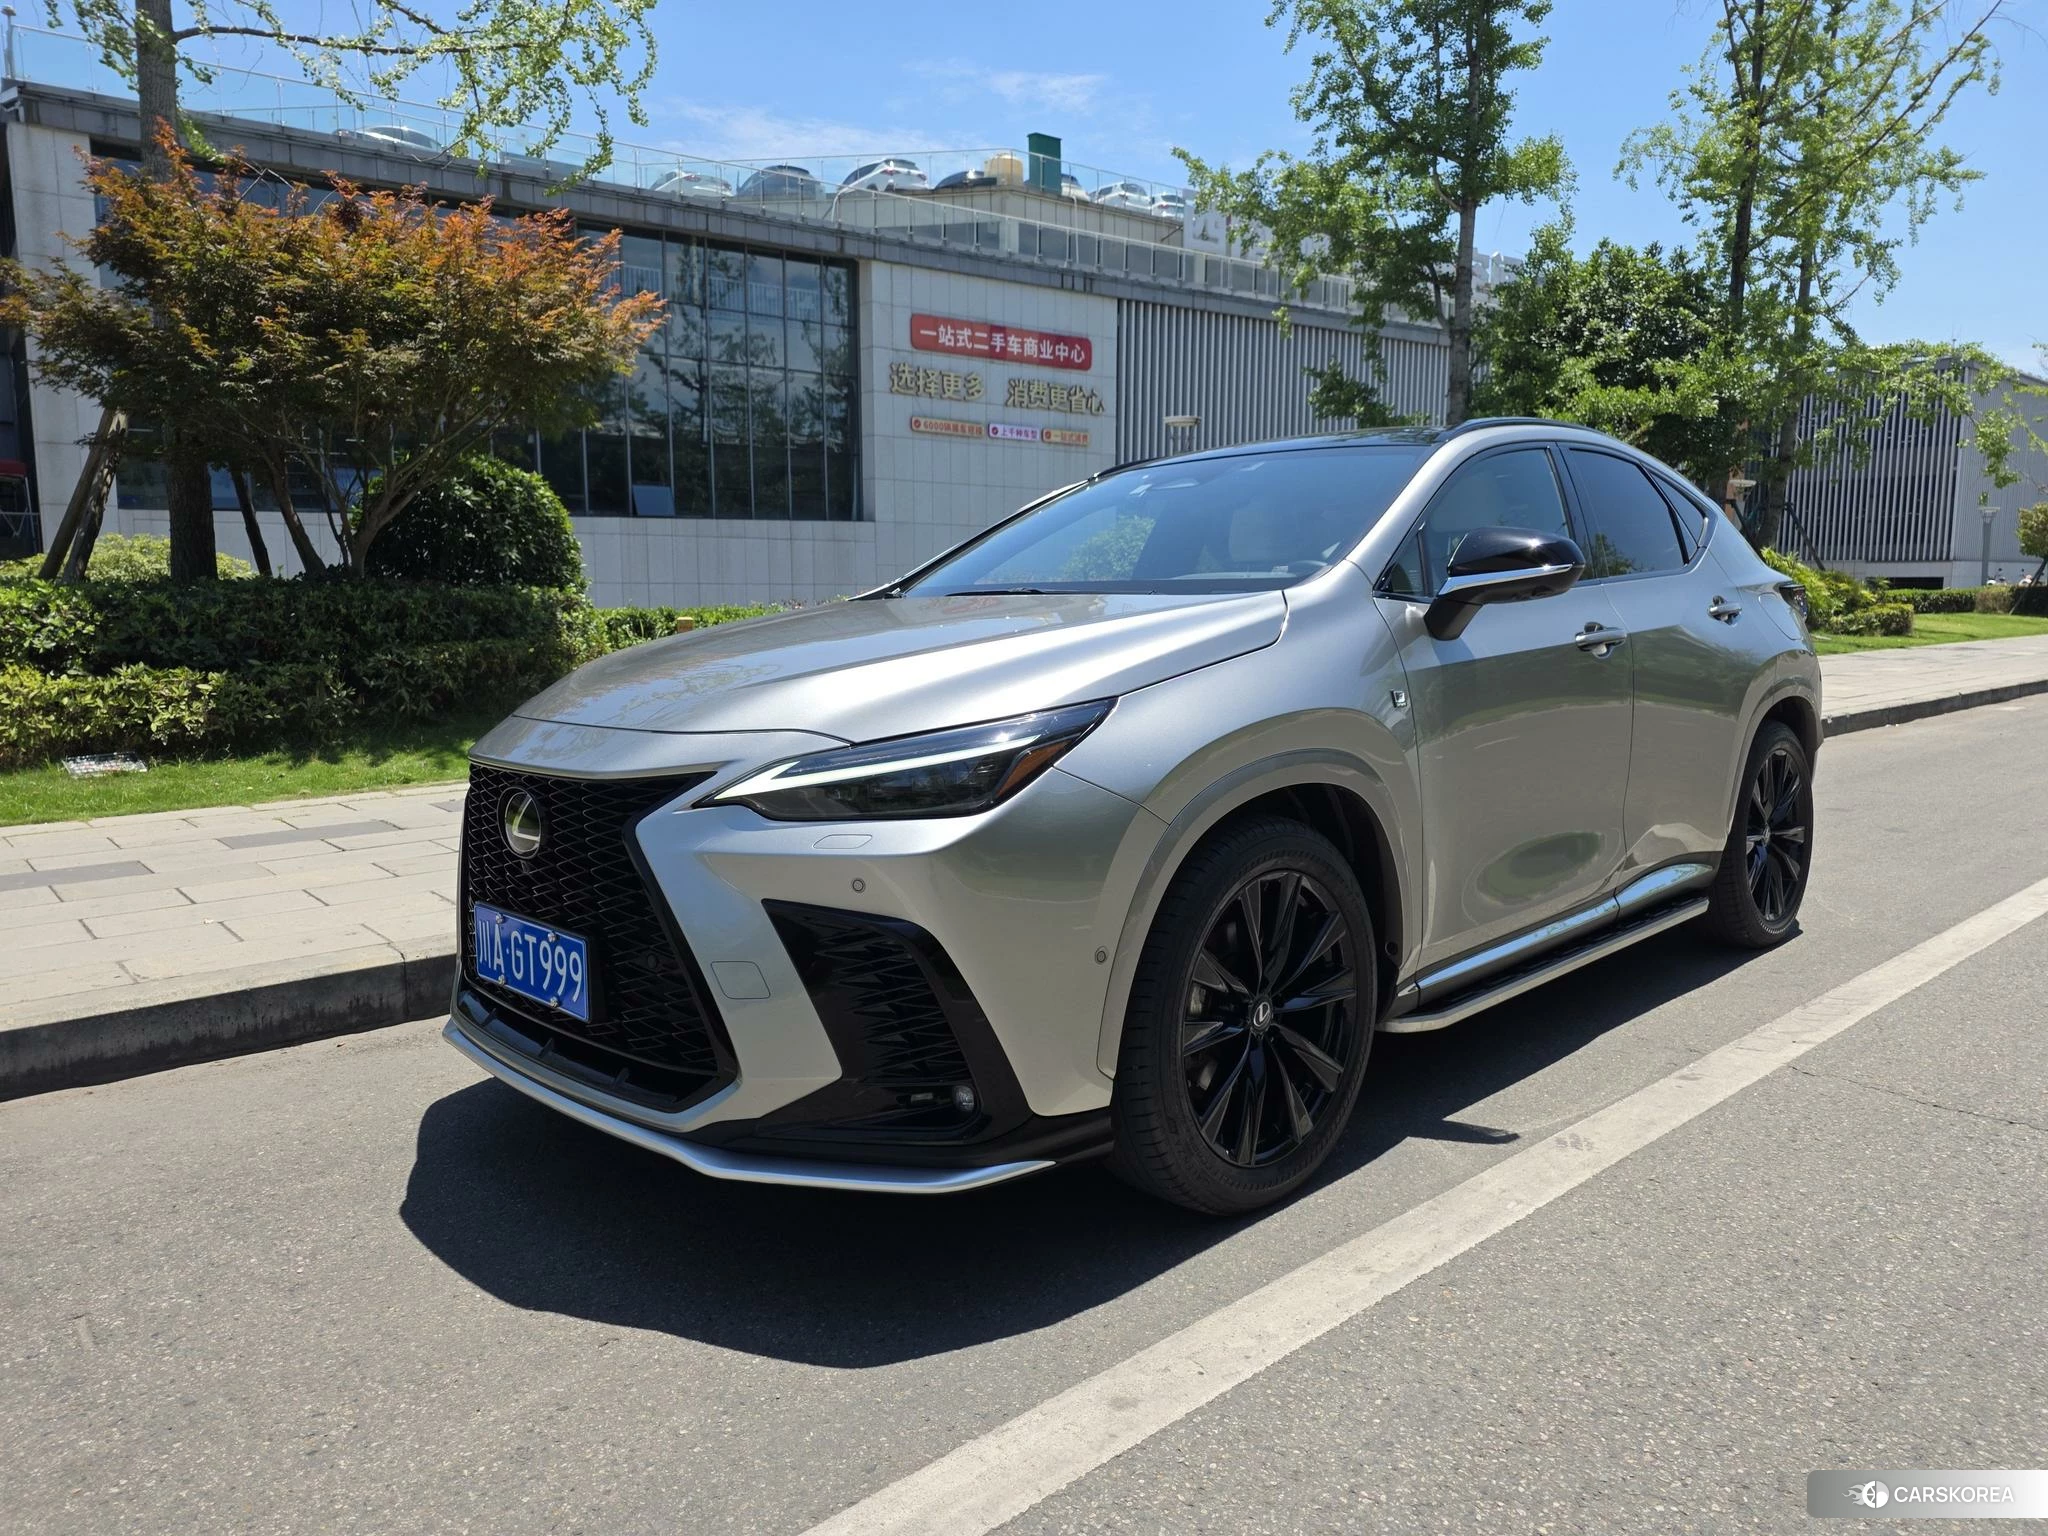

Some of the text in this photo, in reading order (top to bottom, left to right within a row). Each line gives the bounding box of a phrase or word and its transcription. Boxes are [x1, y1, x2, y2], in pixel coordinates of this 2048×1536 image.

[919, 324, 1086, 364] 一站式二手车商业中心
[889, 362, 1105, 416] 选择更多 消费更省心
